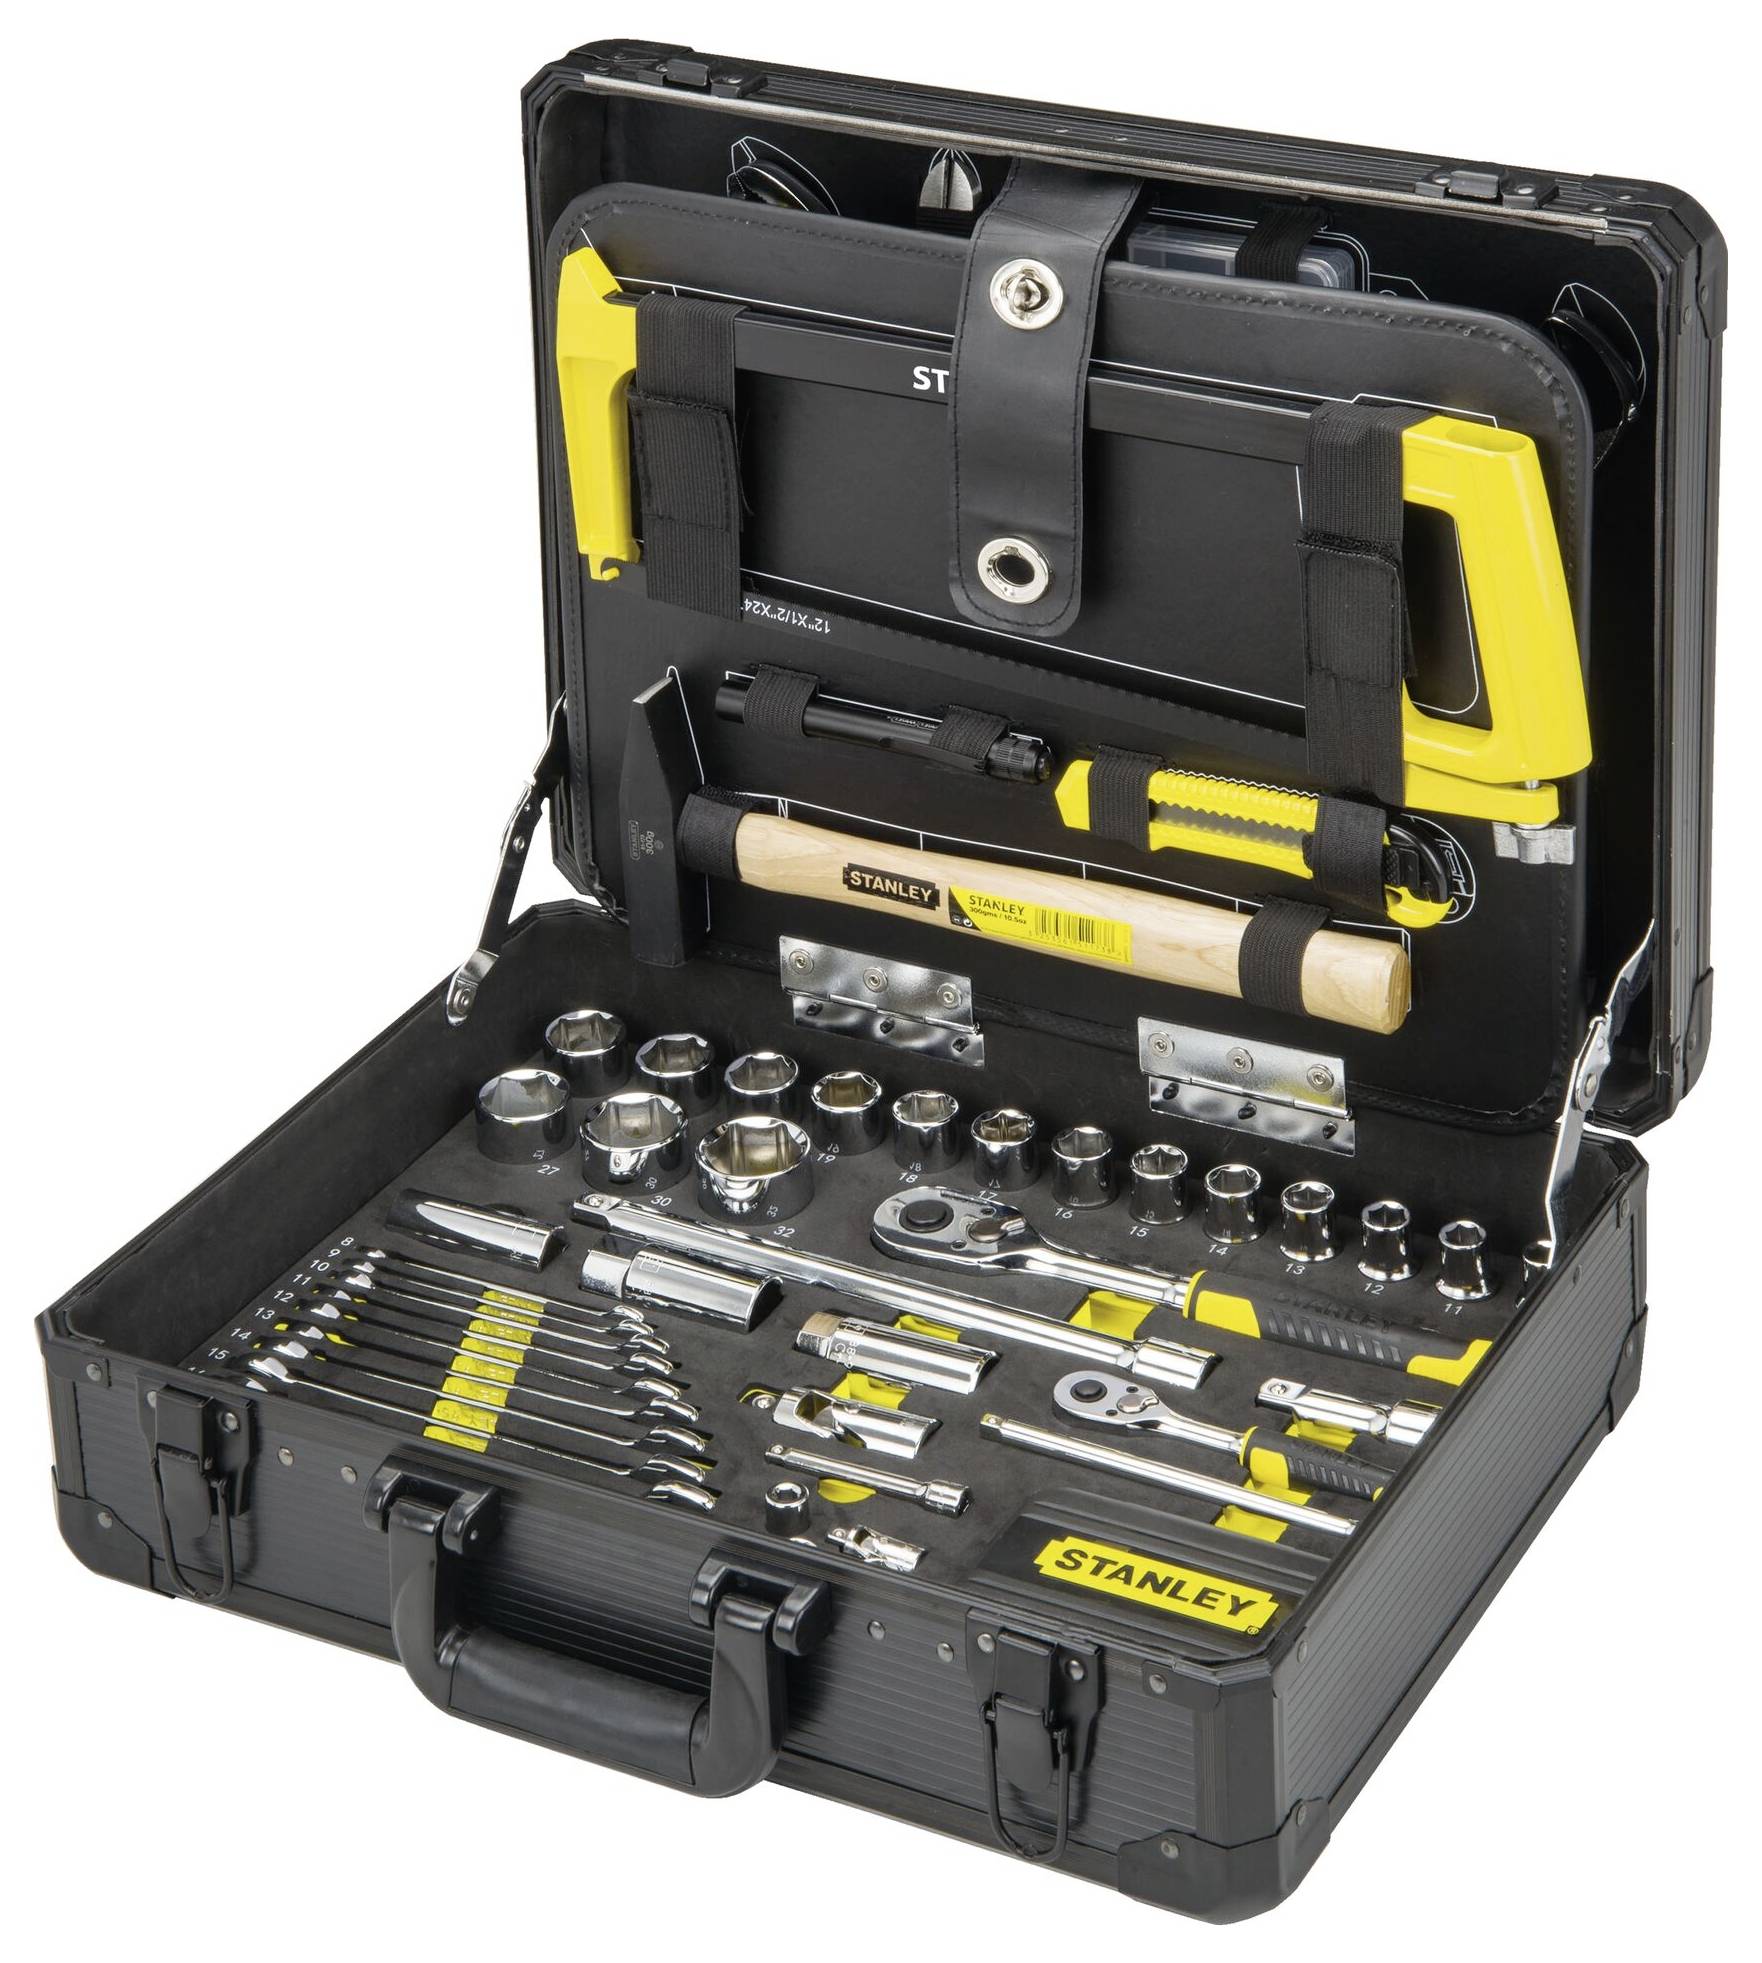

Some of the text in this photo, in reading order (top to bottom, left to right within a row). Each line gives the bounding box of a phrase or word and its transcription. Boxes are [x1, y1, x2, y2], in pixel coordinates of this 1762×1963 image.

[912, 365, 950, 394] ST
[740, 598, 831, 634] 12"X1/2"X24
[850, 870, 932, 902] STANLEY
[968, 894, 1025, 916] STANLEY
[817, 1152, 837, 1164] 19
[536, 1164, 561, 1177] 27
[899, 1171, 919, 1184] 18
[650, 1195, 673, 1208] 30
[977, 1190, 999, 1201] 17
[1054, 1207, 1074, 1220] 16
[773, 1225, 796, 1238] 32
[1128, 1225, 1150, 1238] 15
[340, 1236, 354, 1247] 8
[328, 1248, 341, 1258] 9
[1208, 1244, 1230, 1257] 14
[310, 1259, 330, 1272] 10
[1284, 1263, 1306, 1276] 13
[292, 1273, 312, 1286] 11
[1363, 1282, 1385, 1296] 12
[273, 1289, 295, 1303] 12
[254, 1306, 276, 1320] 13
[1443, 1302, 1464, 1316] 11
[230, 1327, 253, 1341] 14
[207, 1346, 230, 1360] 15
[1055, 1548, 1257, 1617] STANLEY
